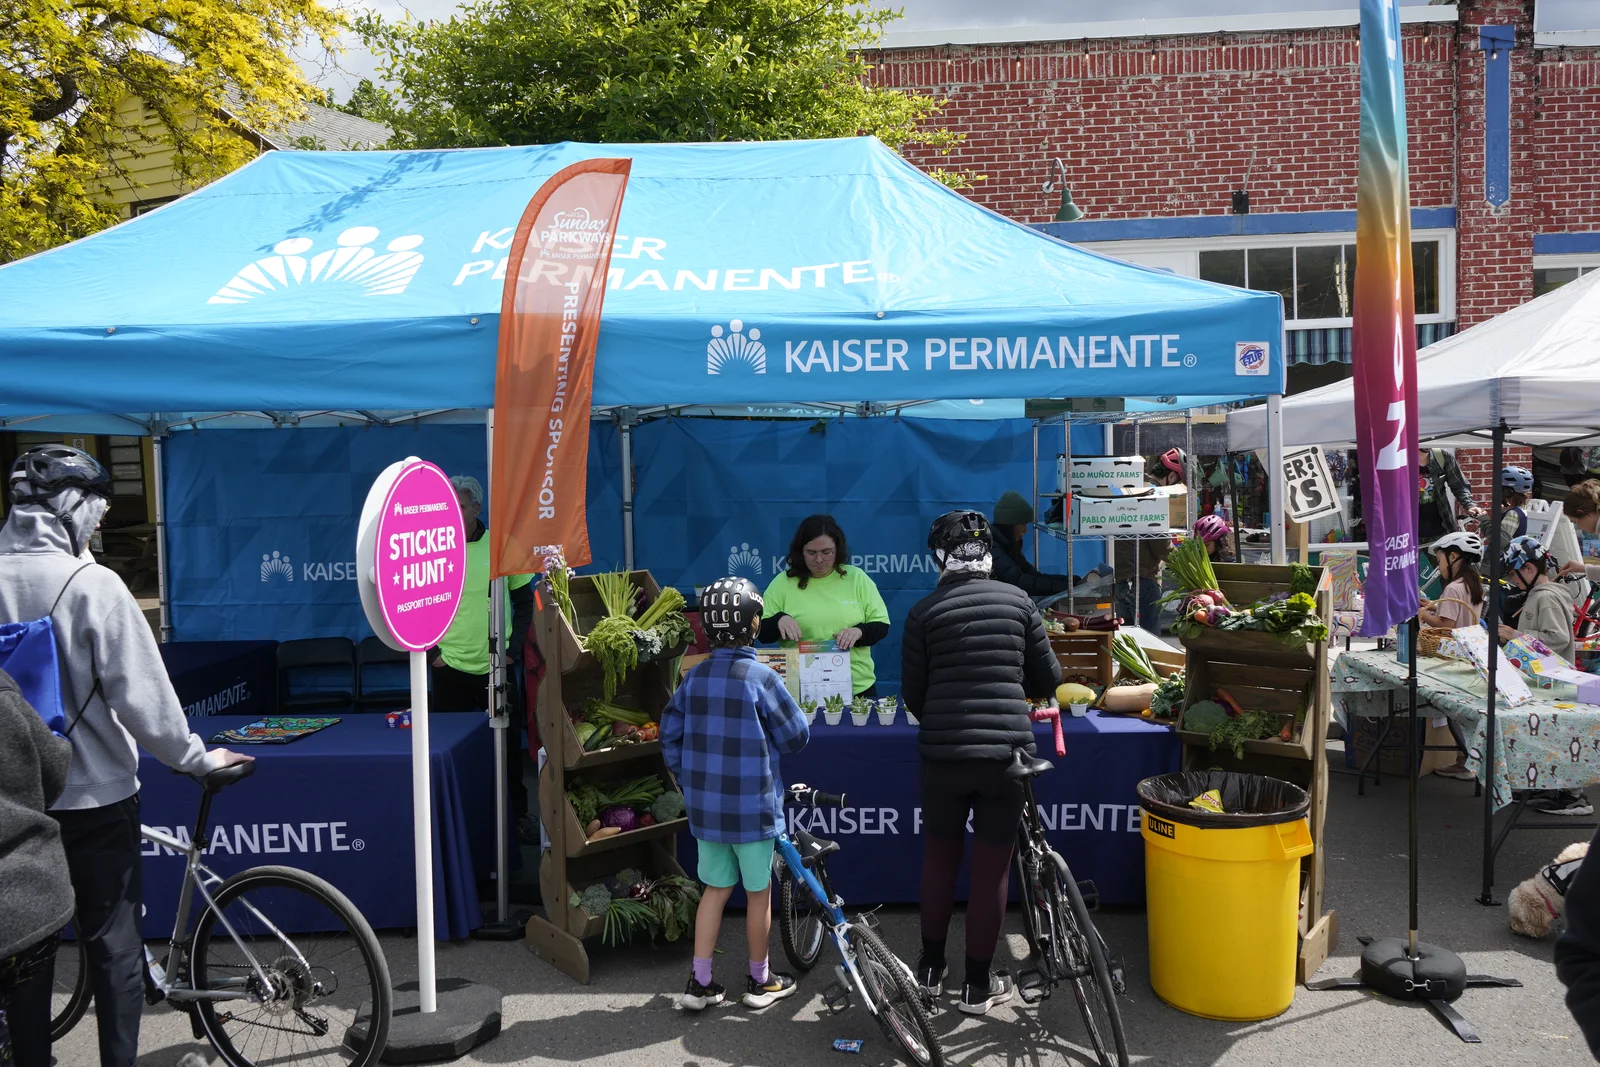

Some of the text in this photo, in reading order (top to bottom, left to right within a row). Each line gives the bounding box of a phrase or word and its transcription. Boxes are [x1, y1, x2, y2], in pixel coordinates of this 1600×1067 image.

[548, 207, 609, 234] Sunday
[551, 281, 579, 413] PRESENTING
[785, 339, 910, 373] KAISER
[1063, 471, 1085, 479] BLO
[1087, 470, 1114, 479] MUÑOZ
[403, 505, 419, 515] KAISER
[1081, 516, 1106, 524] PABLO
[1108, 513, 1138, 523] MUÑOZ
[389, 526, 457, 561] STICKER
[303, 562, 357, 581] KAISE
[403, 558, 447, 590] HUNT
[851, 553, 940, 574] PERMAN
[397, 592, 452, 614] PASSPORT TO HEALTH
[182, 682, 247, 717] RMANENTE
[788, 807, 900, 835] KAISER
[1149, 816, 1174, 836] ULINE
